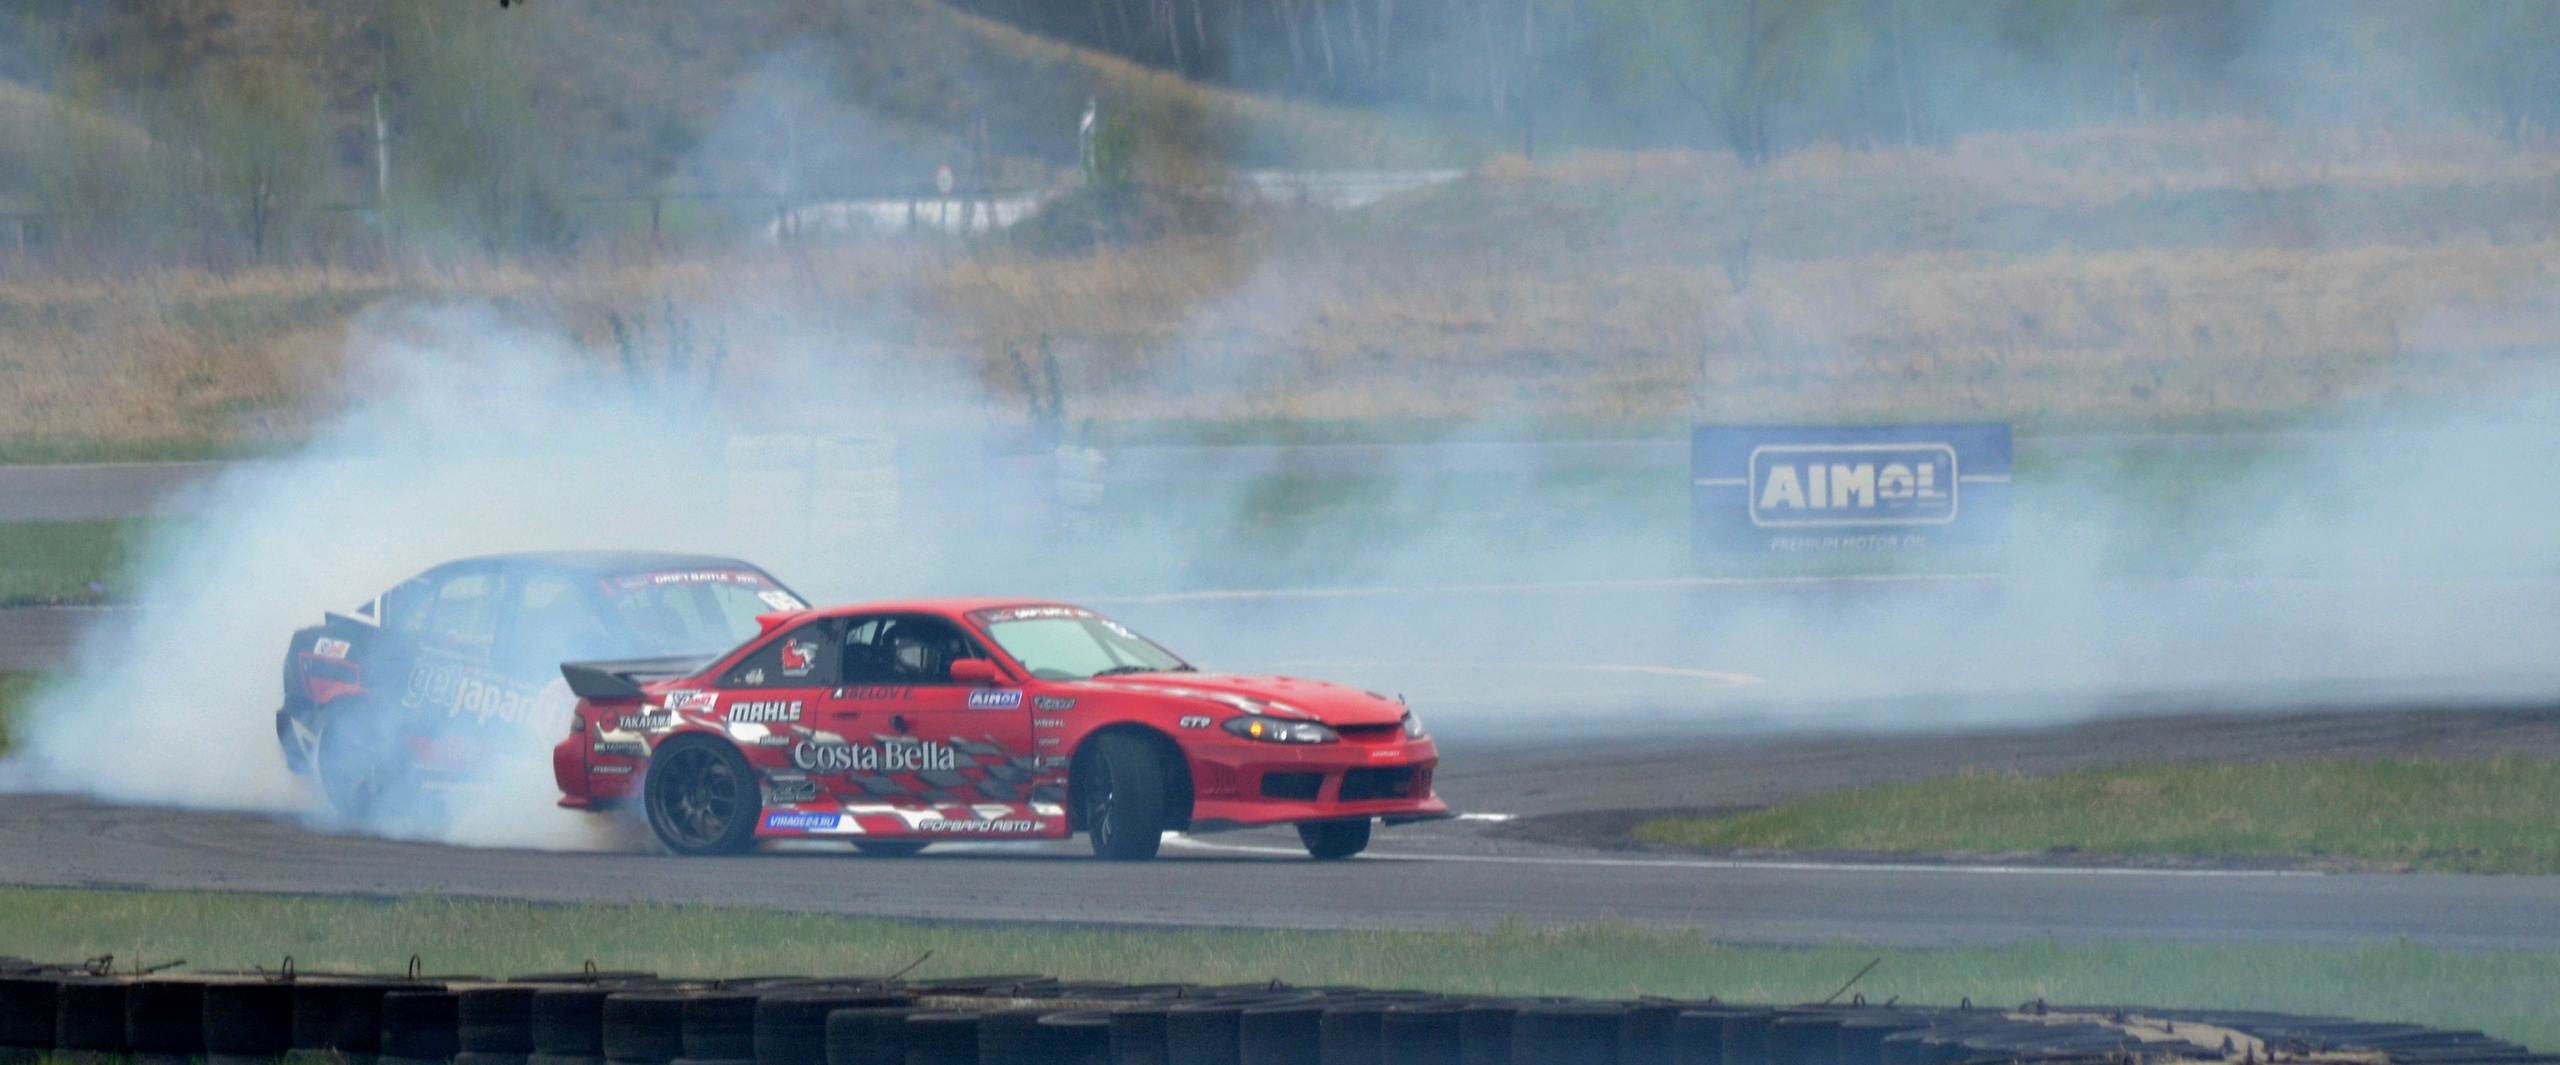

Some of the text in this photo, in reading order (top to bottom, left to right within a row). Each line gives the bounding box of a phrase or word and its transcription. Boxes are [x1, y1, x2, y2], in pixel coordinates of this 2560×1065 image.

[1760, 463, 1947, 508] AIMOL
[1771, 536, 1926, 551] PREMIUM MOTOR OIL
[971, 692, 1019, 706] AIMOL
[728, 702, 802, 722] MAHLE
[619, 715, 672, 729] TAKAYAMA
[795, 740, 955, 770] Costa Bella
[770, 815, 835, 827] VIRAGE24.RU
